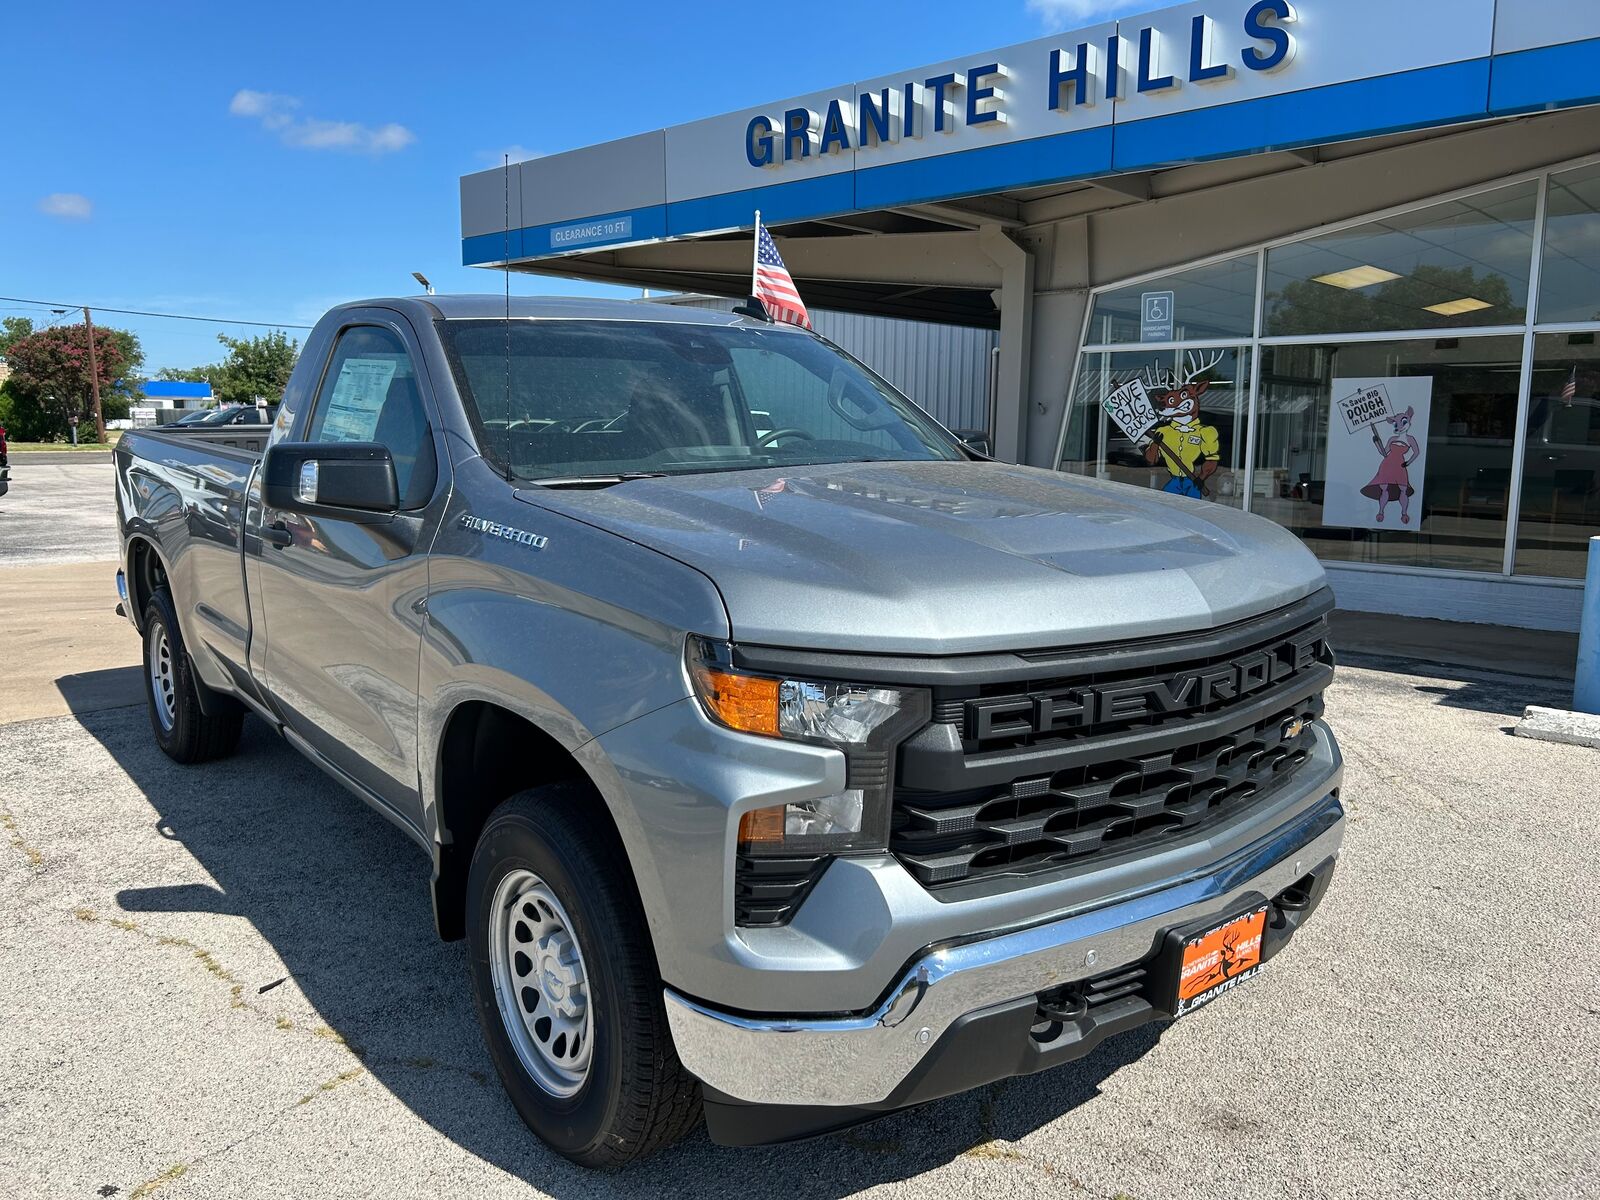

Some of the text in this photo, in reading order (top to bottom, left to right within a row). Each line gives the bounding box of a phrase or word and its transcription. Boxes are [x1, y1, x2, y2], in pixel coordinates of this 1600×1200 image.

[746, 0, 1293, 168] GRANITE HILLS
[555, 221, 626, 242] CLEARANCE 10 FT
[1110, 381, 1142, 409] SAVE
[1346, 396, 1384, 420] DOUGH
[1349, 396, 1366, 407] Save
[1366, 389, 1379, 400] BIG
[1116, 397, 1146, 425] BIG
[1126, 408, 1156, 438] BUCKS
[1359, 407, 1388, 423] LLANO!
[461, 514, 549, 549] SILVERADO
[1235, 934, 1262, 952] HILLS
[1191, 964, 1264, 1008] GRANITE HILLS
